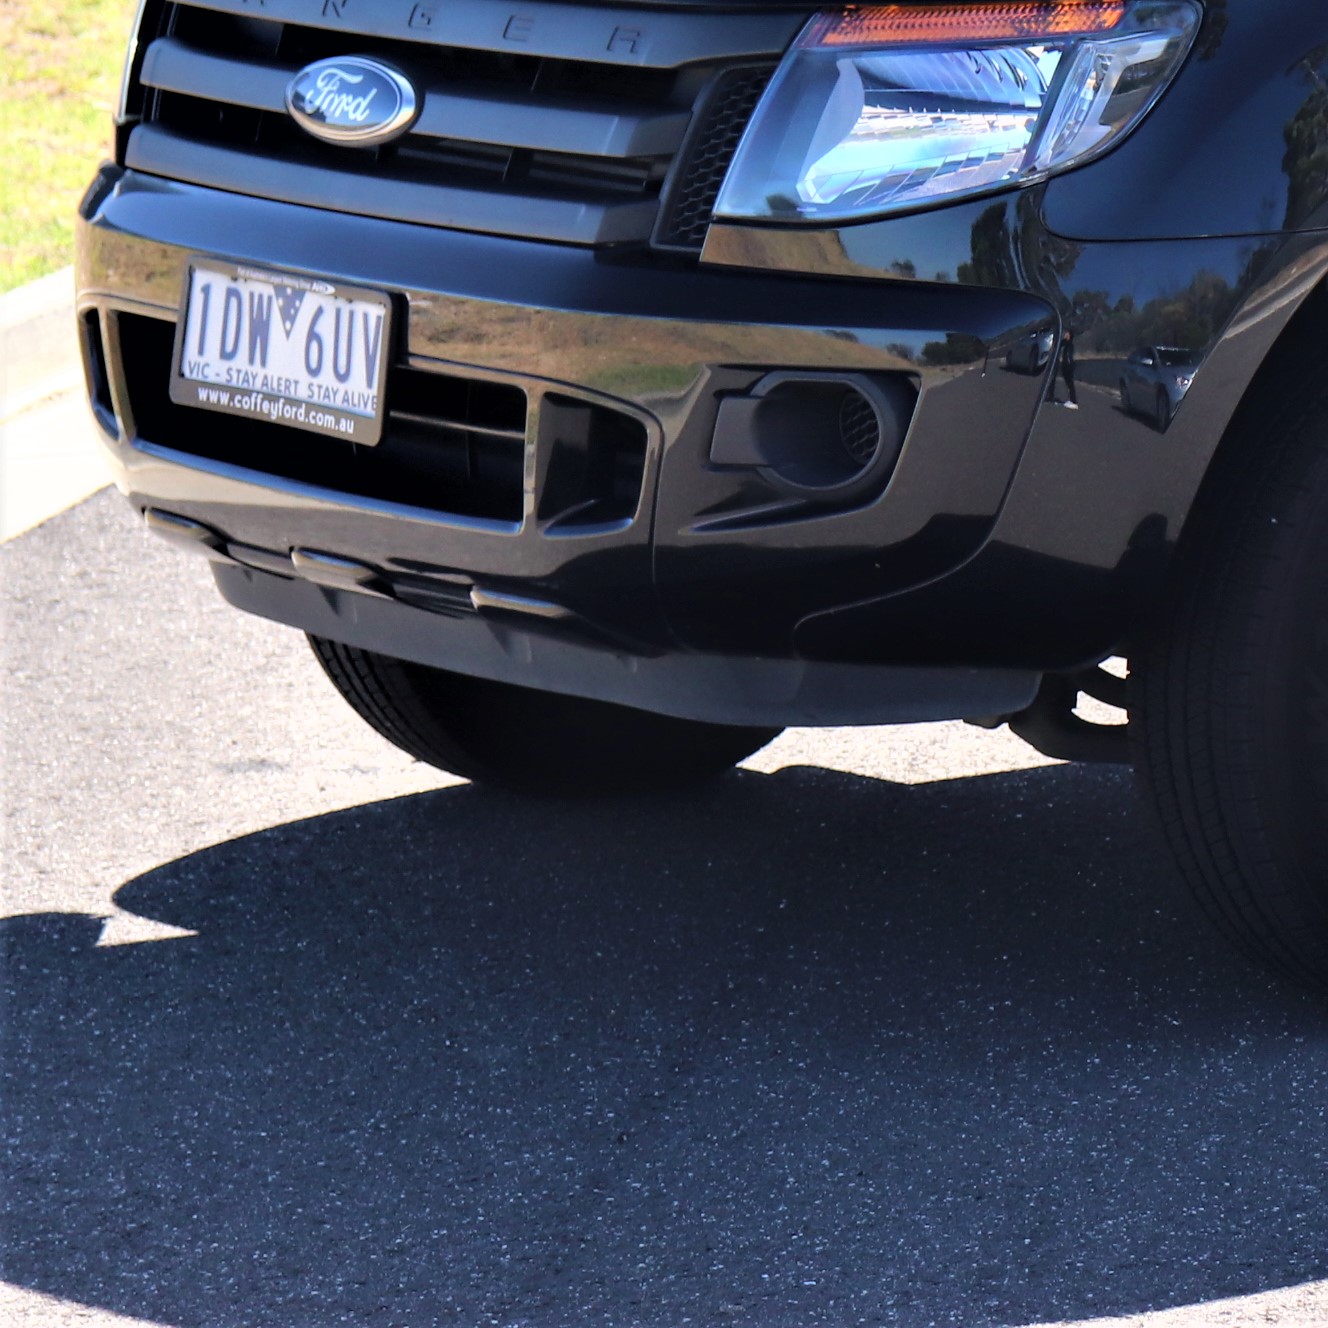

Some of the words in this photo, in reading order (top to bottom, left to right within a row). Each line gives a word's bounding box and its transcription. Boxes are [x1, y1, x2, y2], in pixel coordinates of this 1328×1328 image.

[304, 68, 378, 123] Ford
[198, 283, 273, 369] 1DW
[304, 304, 383, 389] 6UV
[187, 360, 211, 379] VIC
[225, 367, 259, 391] STAY
[261, 376, 299, 396] ALERT
[307, 382, 340, 406] STAY
[342, 391, 378, 410] ALIVE
[198, 387, 354, 434] www.coffeyford.com.au
